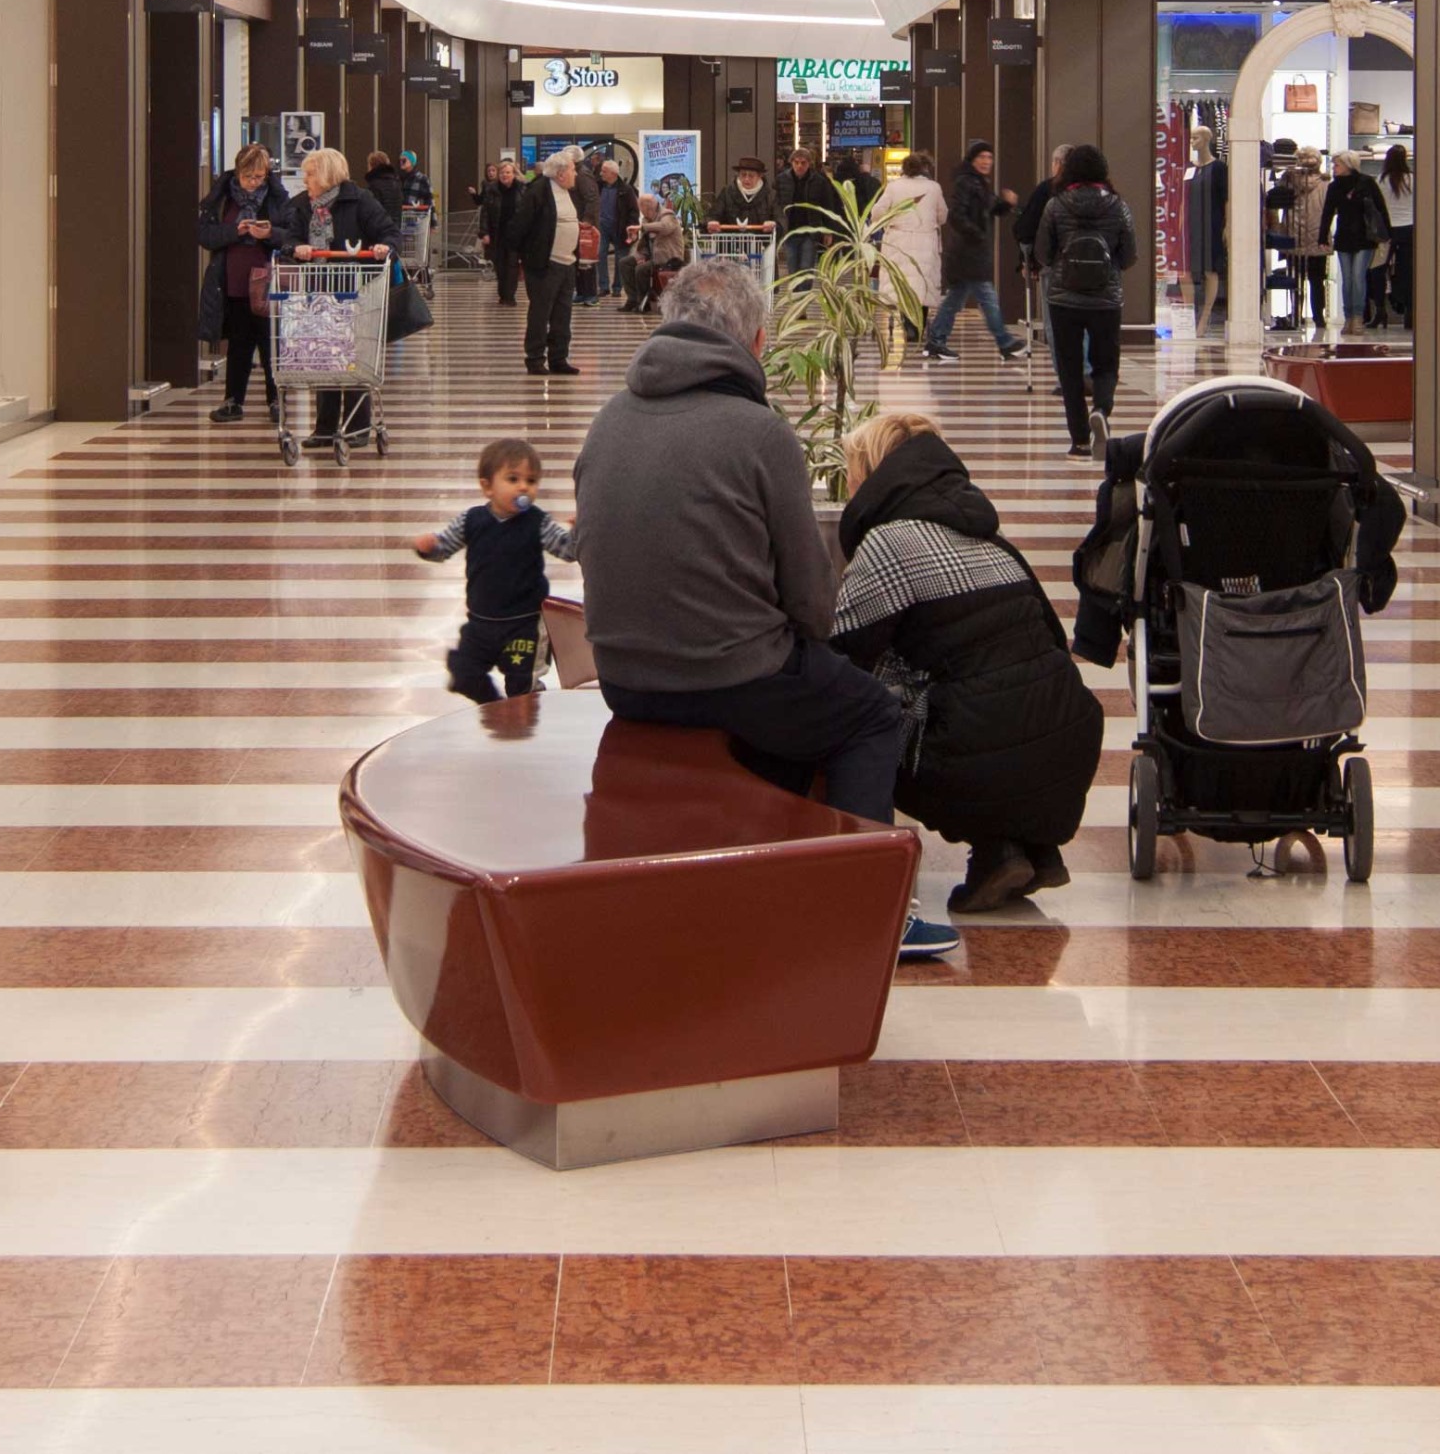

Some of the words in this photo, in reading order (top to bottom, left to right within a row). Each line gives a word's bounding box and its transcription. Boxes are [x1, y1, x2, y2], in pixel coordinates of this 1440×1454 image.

[569, 66, 618, 86] Store
[844, 110, 871, 119] SPOT
[860, 127, 881, 135] EURO
